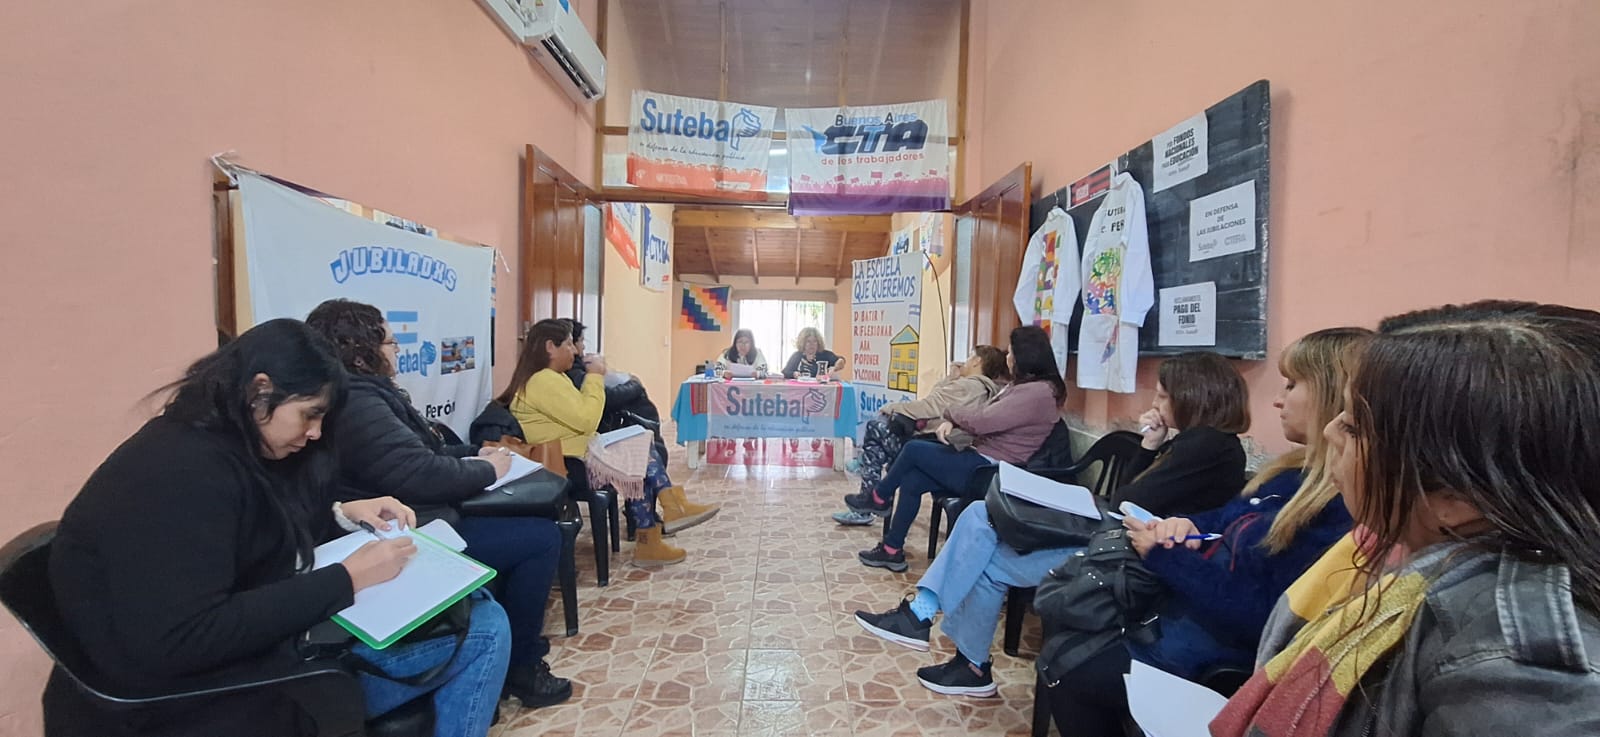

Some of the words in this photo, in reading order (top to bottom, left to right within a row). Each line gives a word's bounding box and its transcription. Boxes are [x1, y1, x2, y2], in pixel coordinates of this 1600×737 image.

[641, 98, 730, 142] Suteba
[835, 114, 881, 127] Buenos
[884, 112, 918, 124] Aires
[821, 119, 929, 155] CTA
[1173, 127, 1195, 146] FONDOS
[1164, 136, 1196, 158] NACIONALES
[856, 152, 925, 164] trabajadores
[1205, 210, 1213, 218] EN
[1213, 202, 1239, 215] DEFENSA
[1206, 217, 1247, 233] JUBILACIONES
[1216, 215, 1225, 223] DE
[329, 246, 458, 292] JUBILADXS
[855, 261, 865, 280] LA
[867, 256, 901, 279] ESCUELA
[872, 275, 915, 303] QUEREMOS
[854, 309, 878, 322] DBATIR
[880, 309, 886, 321] Y
[1173, 303, 1189, 314] PAGO
[1190, 302, 1201, 313] DEL
[854, 325, 893, 336] RFLEXIONAR
[860, 340, 871, 351] ARA
[396, 349, 419, 374] eba
[854, 353, 880, 366] POPONER
[726, 386, 801, 418] Suteba
[860, 390, 894, 413] Suteb
